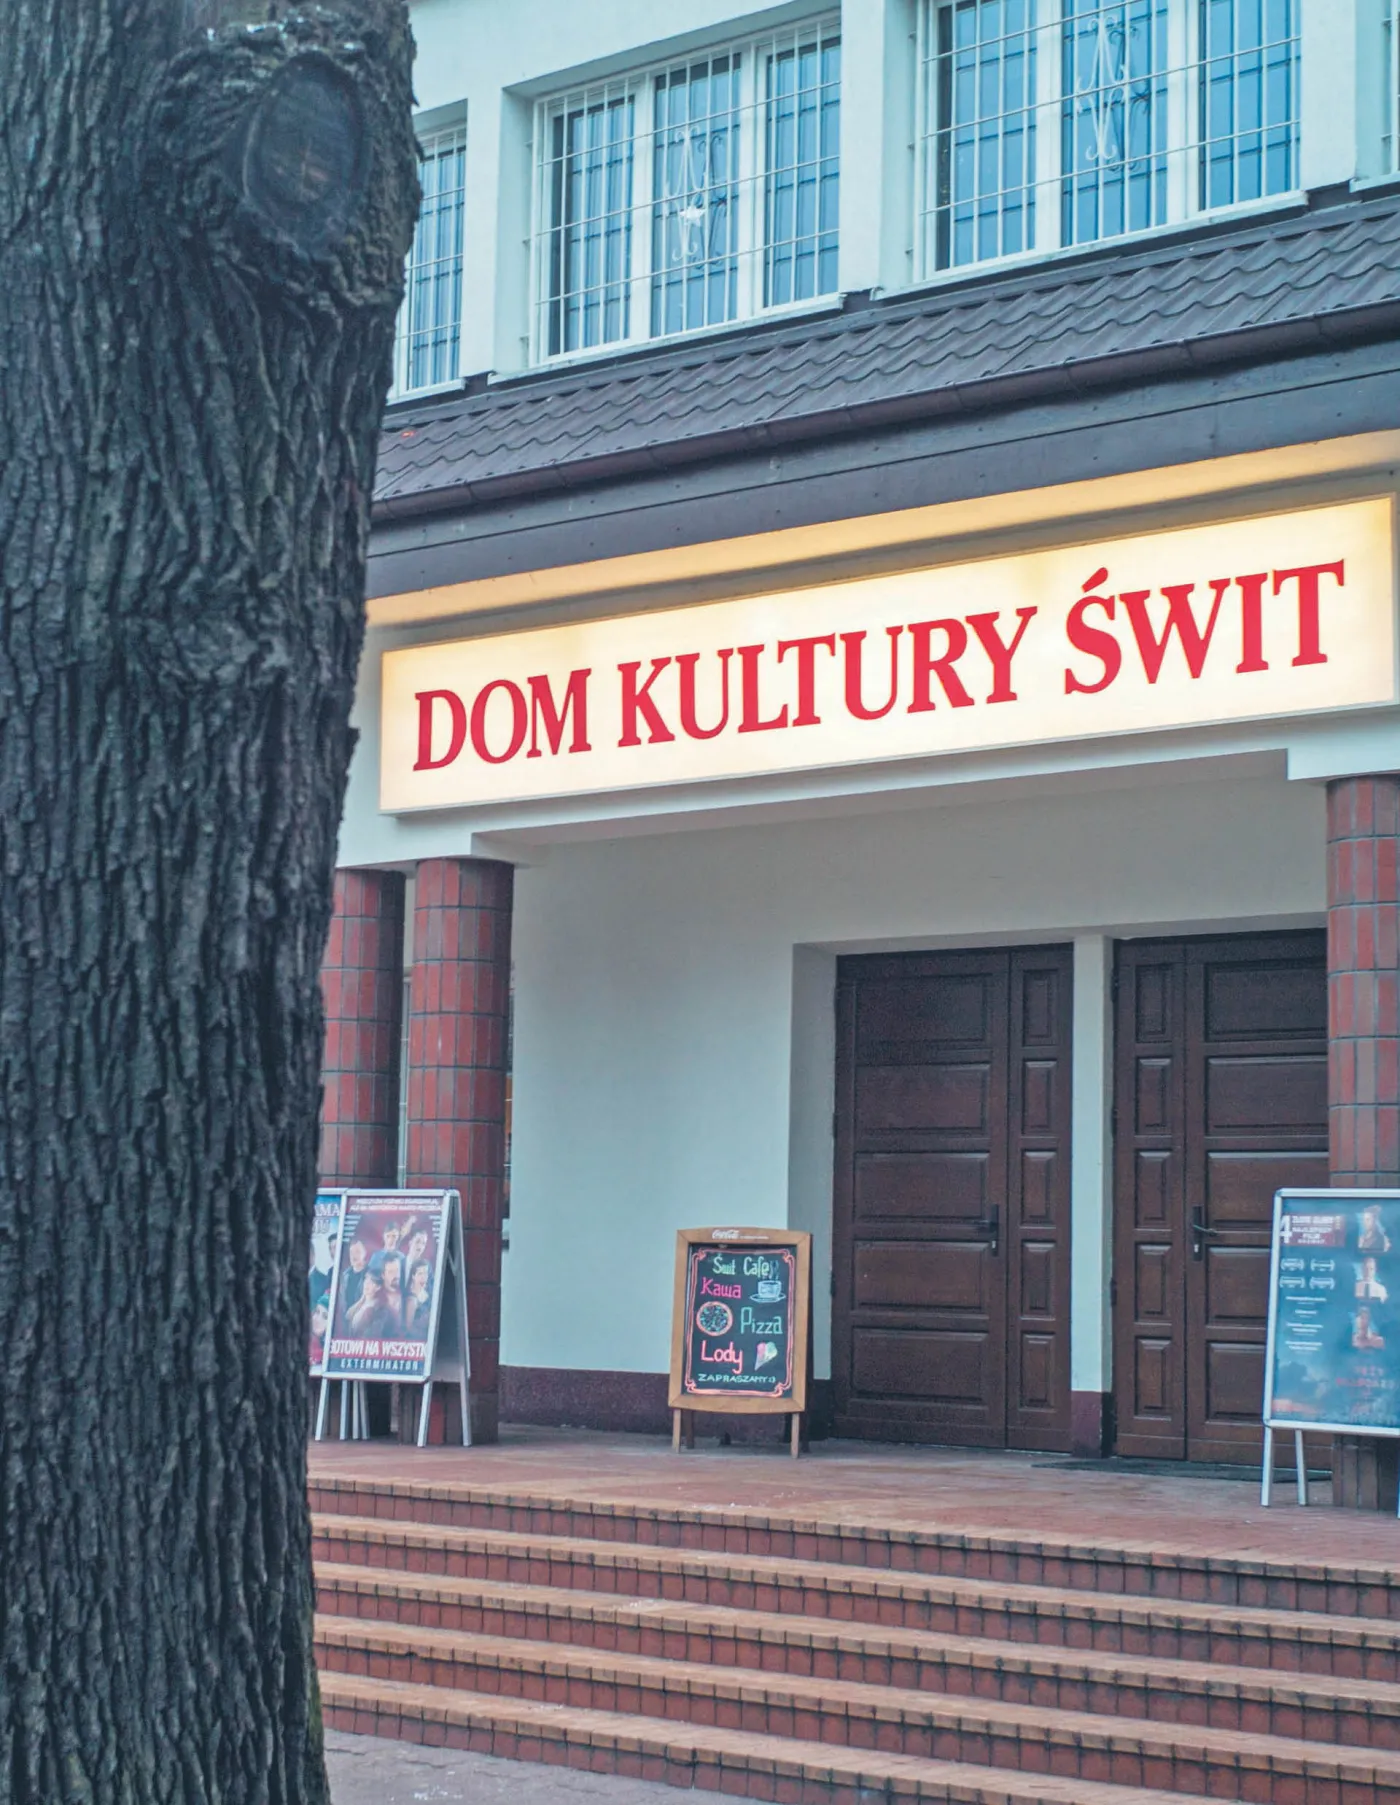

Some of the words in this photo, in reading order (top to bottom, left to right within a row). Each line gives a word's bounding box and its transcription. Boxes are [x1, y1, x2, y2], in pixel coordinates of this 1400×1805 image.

[413, 669, 592, 771] DOM
[617, 606, 1038, 748] KULTURY
[1064, 560, 1345, 695] ŚWIT
[743, 1256, 770, 1278] Cafe
[701, 1277, 742, 1299] Kawa
[740, 1306, 783, 1335] Pizza
[365, 1339, 380, 1356] NA
[701, 1340, 743, 1374] Lody
